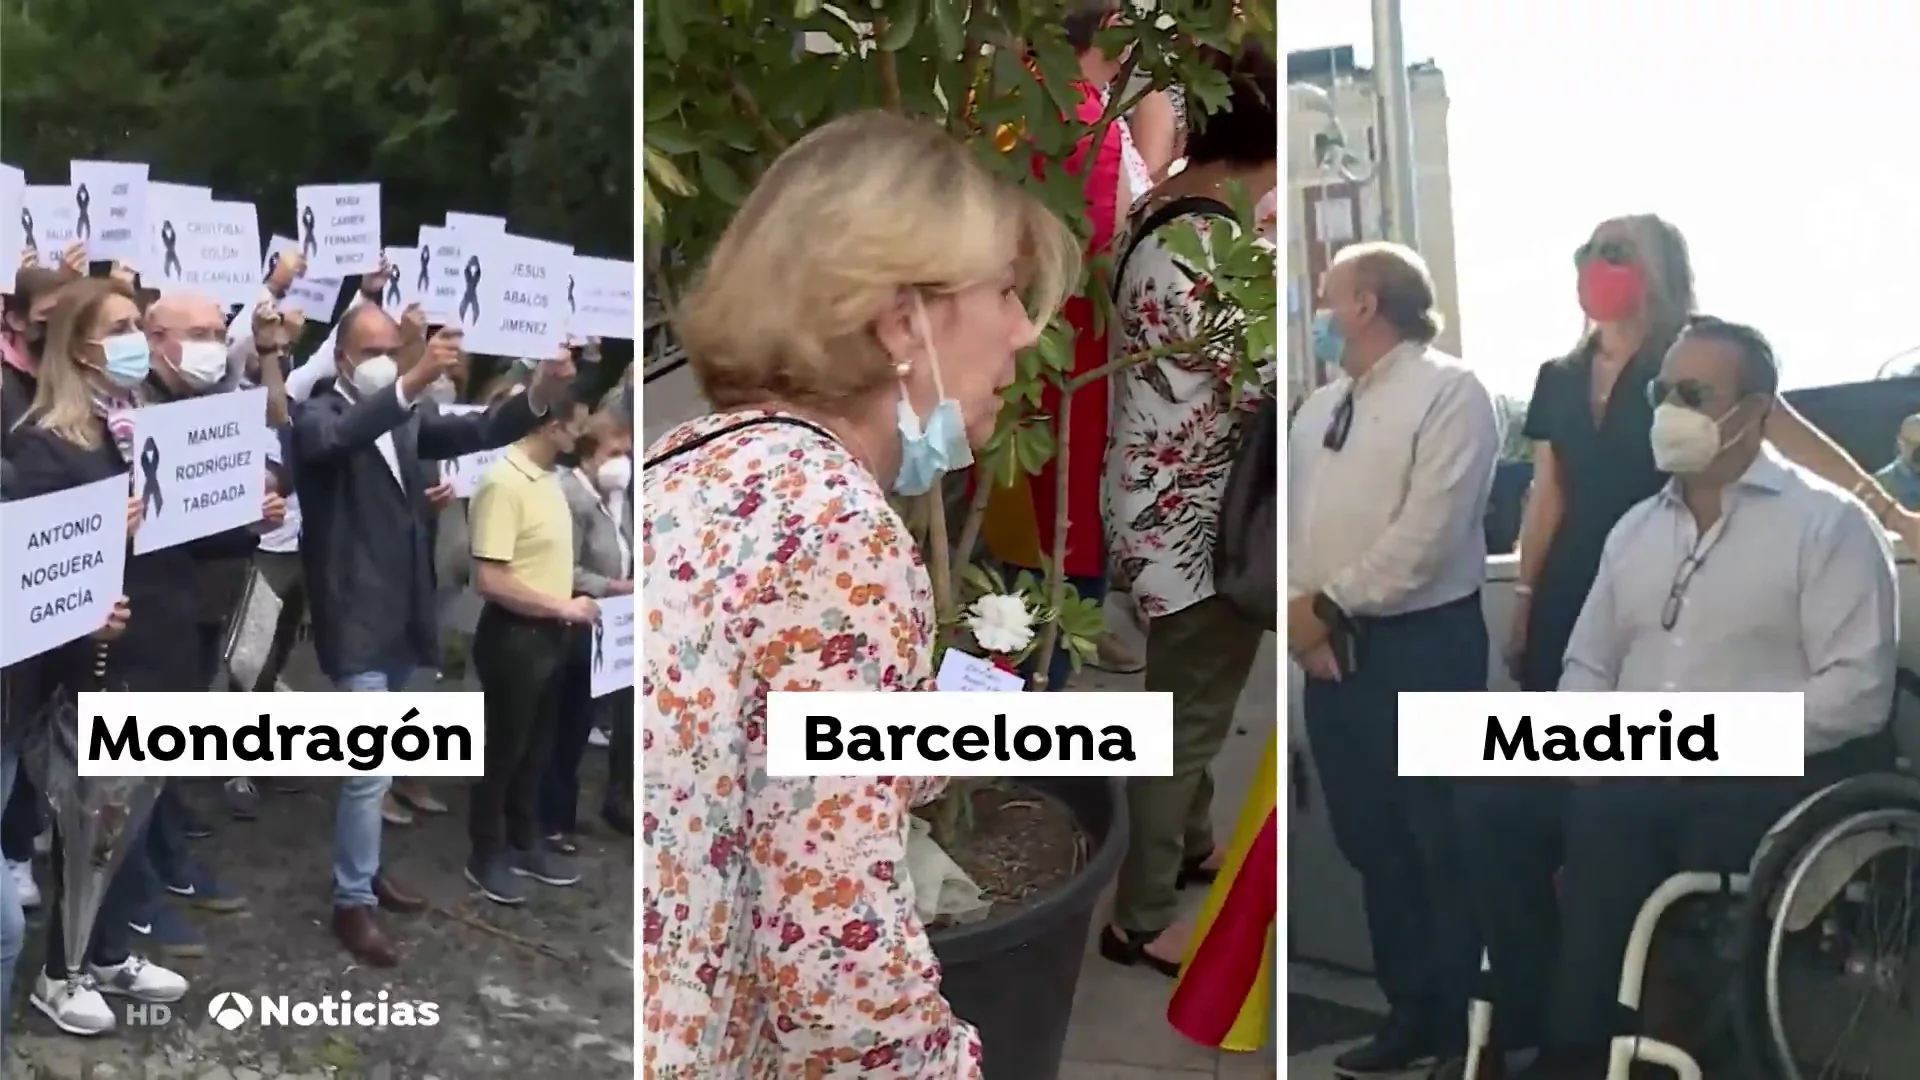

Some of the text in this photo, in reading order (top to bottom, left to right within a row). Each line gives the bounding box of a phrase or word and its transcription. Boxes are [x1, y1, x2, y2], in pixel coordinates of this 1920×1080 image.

[187, 421, 241, 446] MANUEL
[175, 449, 252, 482] RODRÍGUEZ
[182, 484, 247, 514] TABOADA
[27, 513, 103, 551] ANTONIO
[20, 550, 104, 590] NOGUERA
[29, 587, 94, 624] GARCÍA
